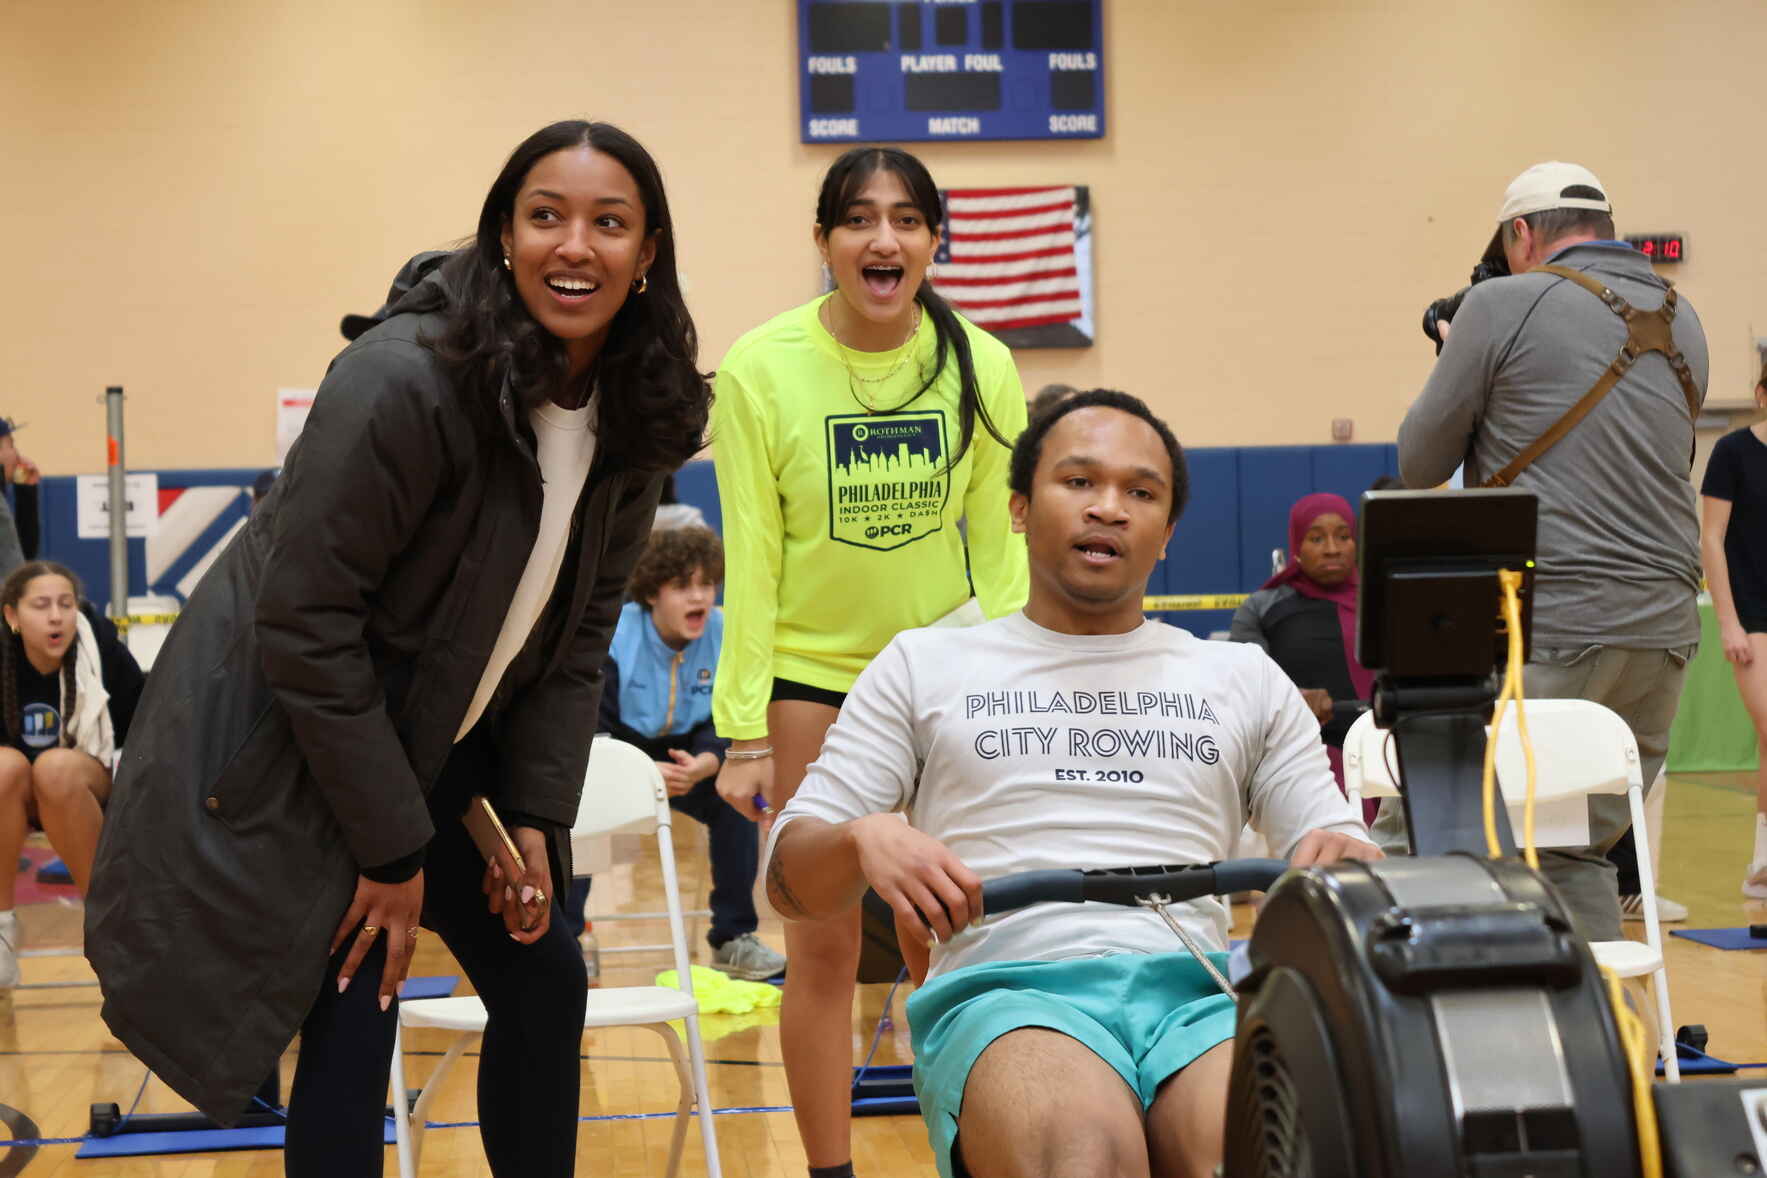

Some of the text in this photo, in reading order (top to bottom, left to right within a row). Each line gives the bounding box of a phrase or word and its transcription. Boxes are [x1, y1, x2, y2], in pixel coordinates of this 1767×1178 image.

[808, 56, 857, 74] FOULS
[900, 54, 1003, 73] PLAYER FOUL
[1048, 53, 1097, 71] FOULS
[809, 118, 858, 137] SCORE
[928, 117, 980, 134] MATCH
[1048, 114, 1097, 133] SCORE
[870, 426, 920, 436] ROTHMAN
[839, 481, 941, 503] PHILADELPHIA
[840, 500, 939, 514] INDOOR CLASSIC
[880, 523, 912, 537] PCR
[966, 691, 1220, 725] PHILADELPHIA
[975, 727, 1220, 765] CITY ROWING
[1055, 769, 1144, 783] EST. 2010
